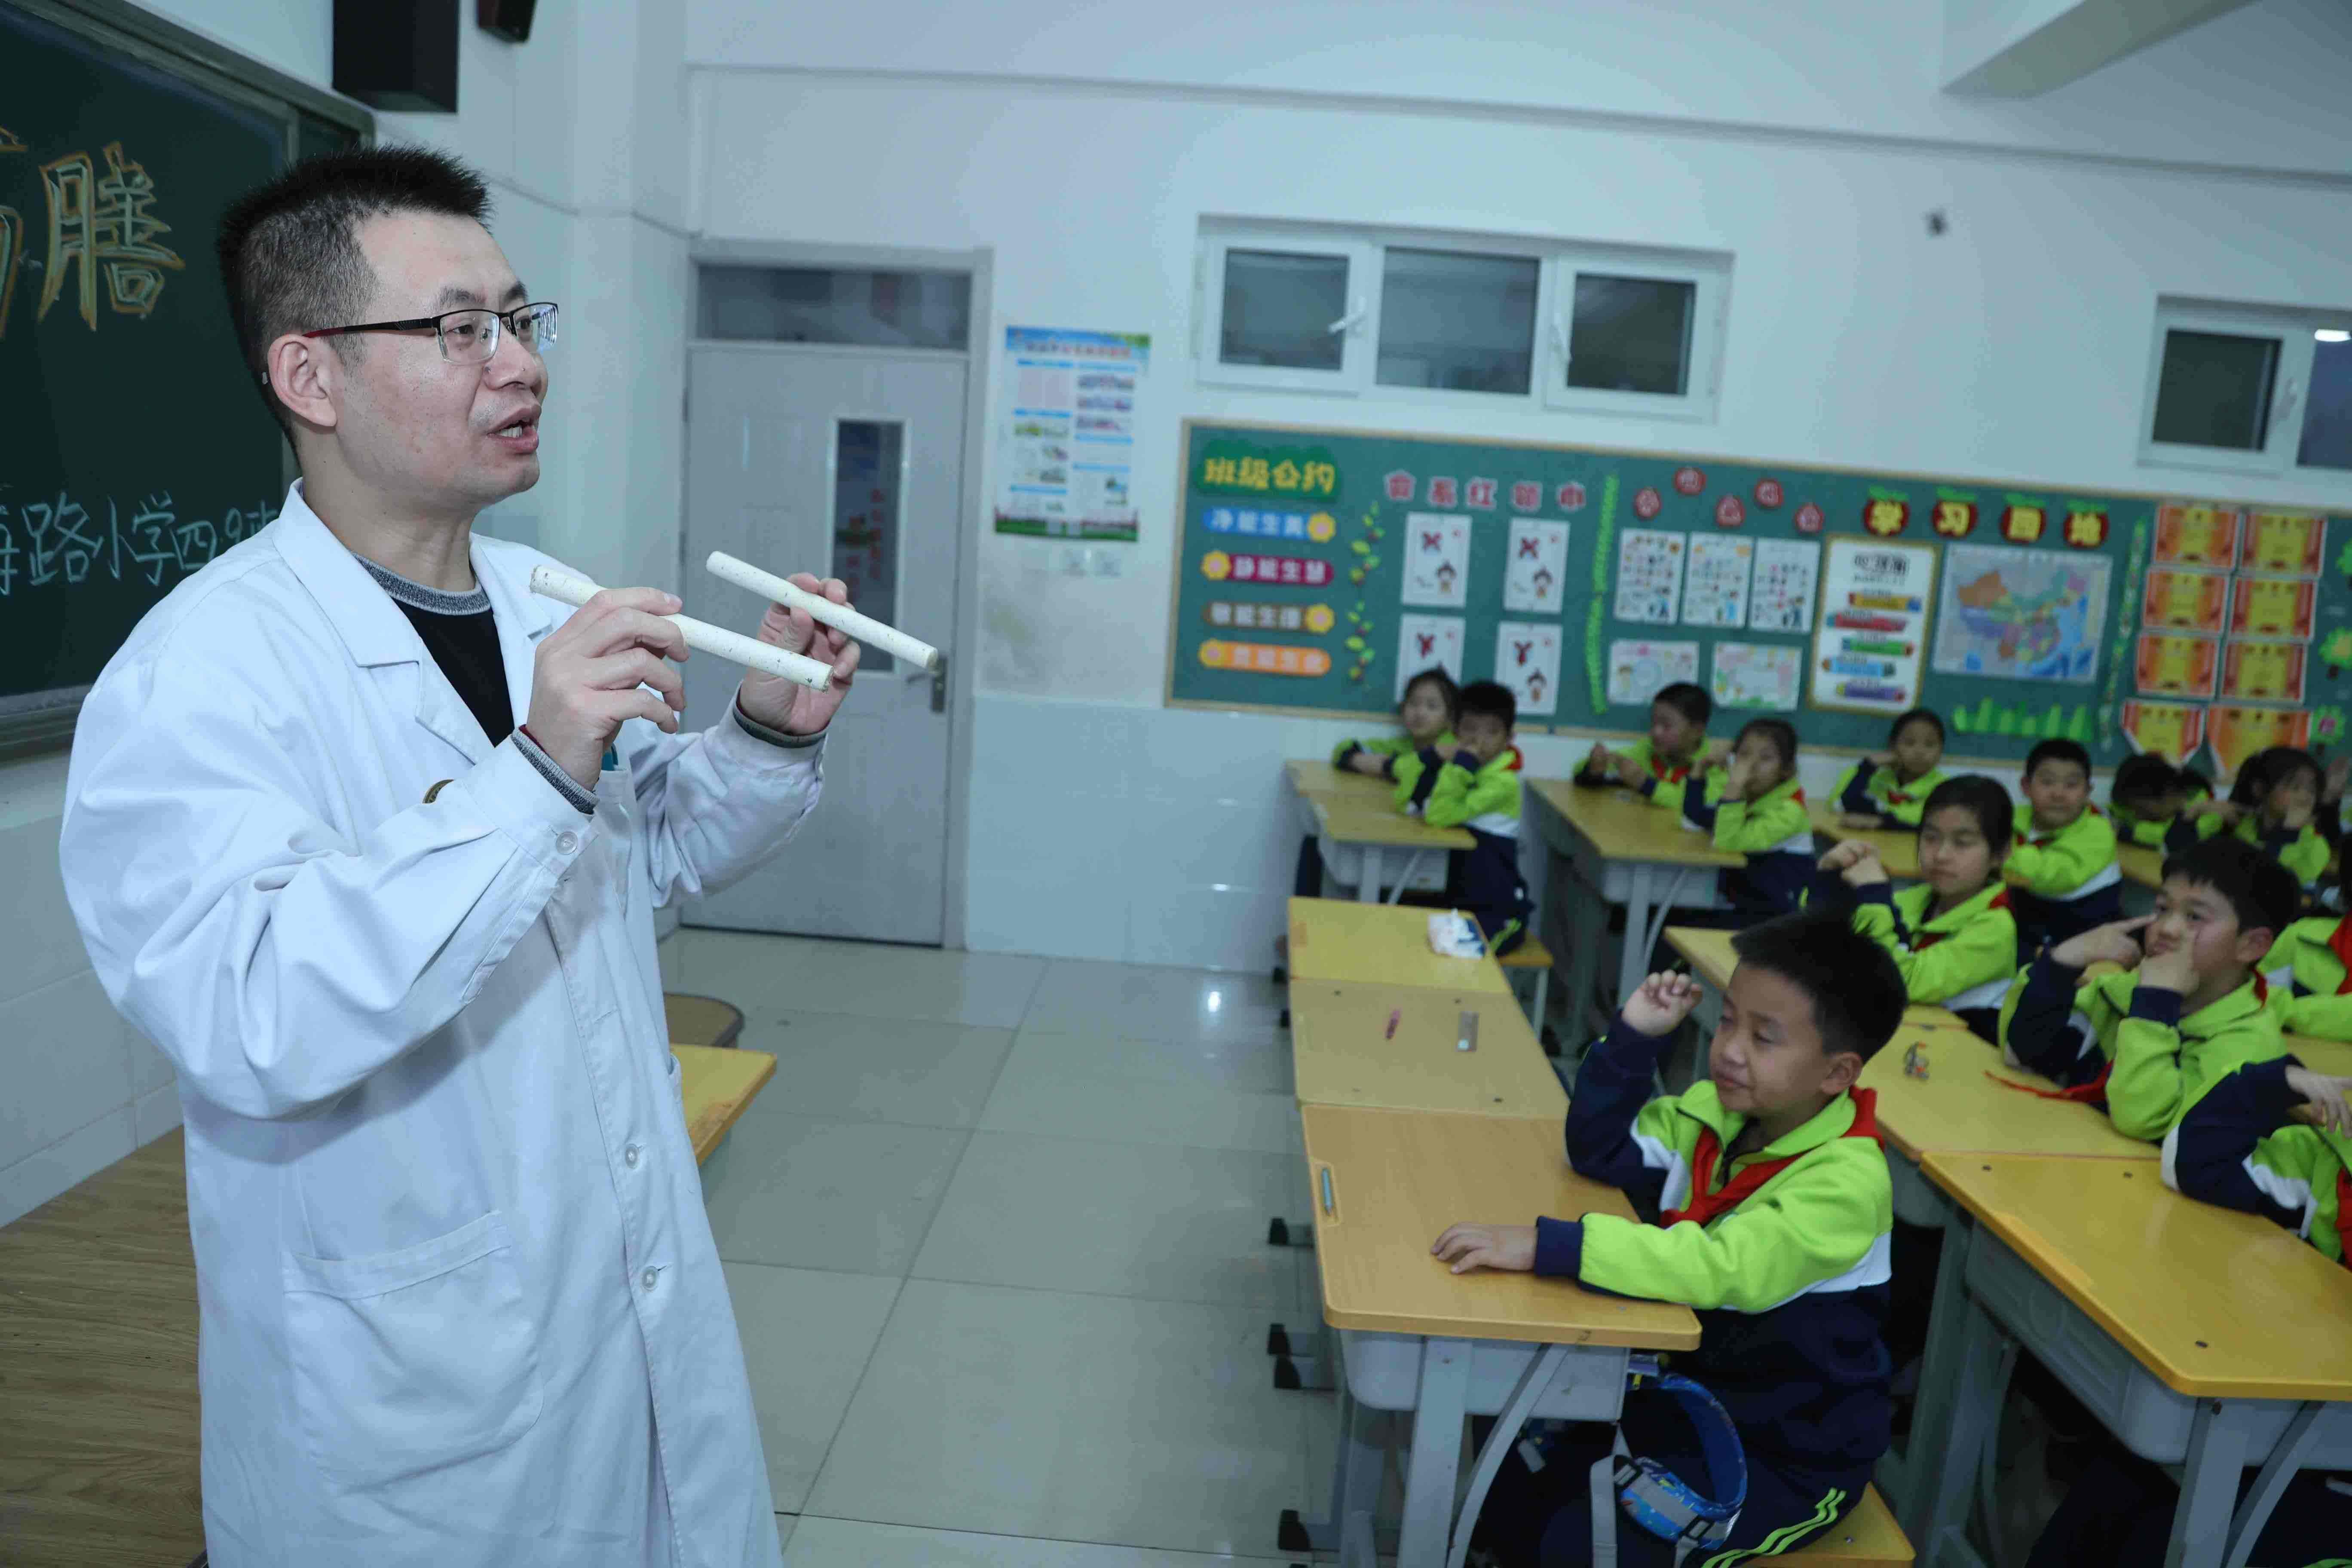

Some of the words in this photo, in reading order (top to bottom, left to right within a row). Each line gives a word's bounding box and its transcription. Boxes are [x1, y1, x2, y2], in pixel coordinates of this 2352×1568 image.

[1205, 456, 1335, 494] 班级公约
[0, 490, 279, 595] 路小学四9
[1870, 501, 2102, 546] 学习园地
